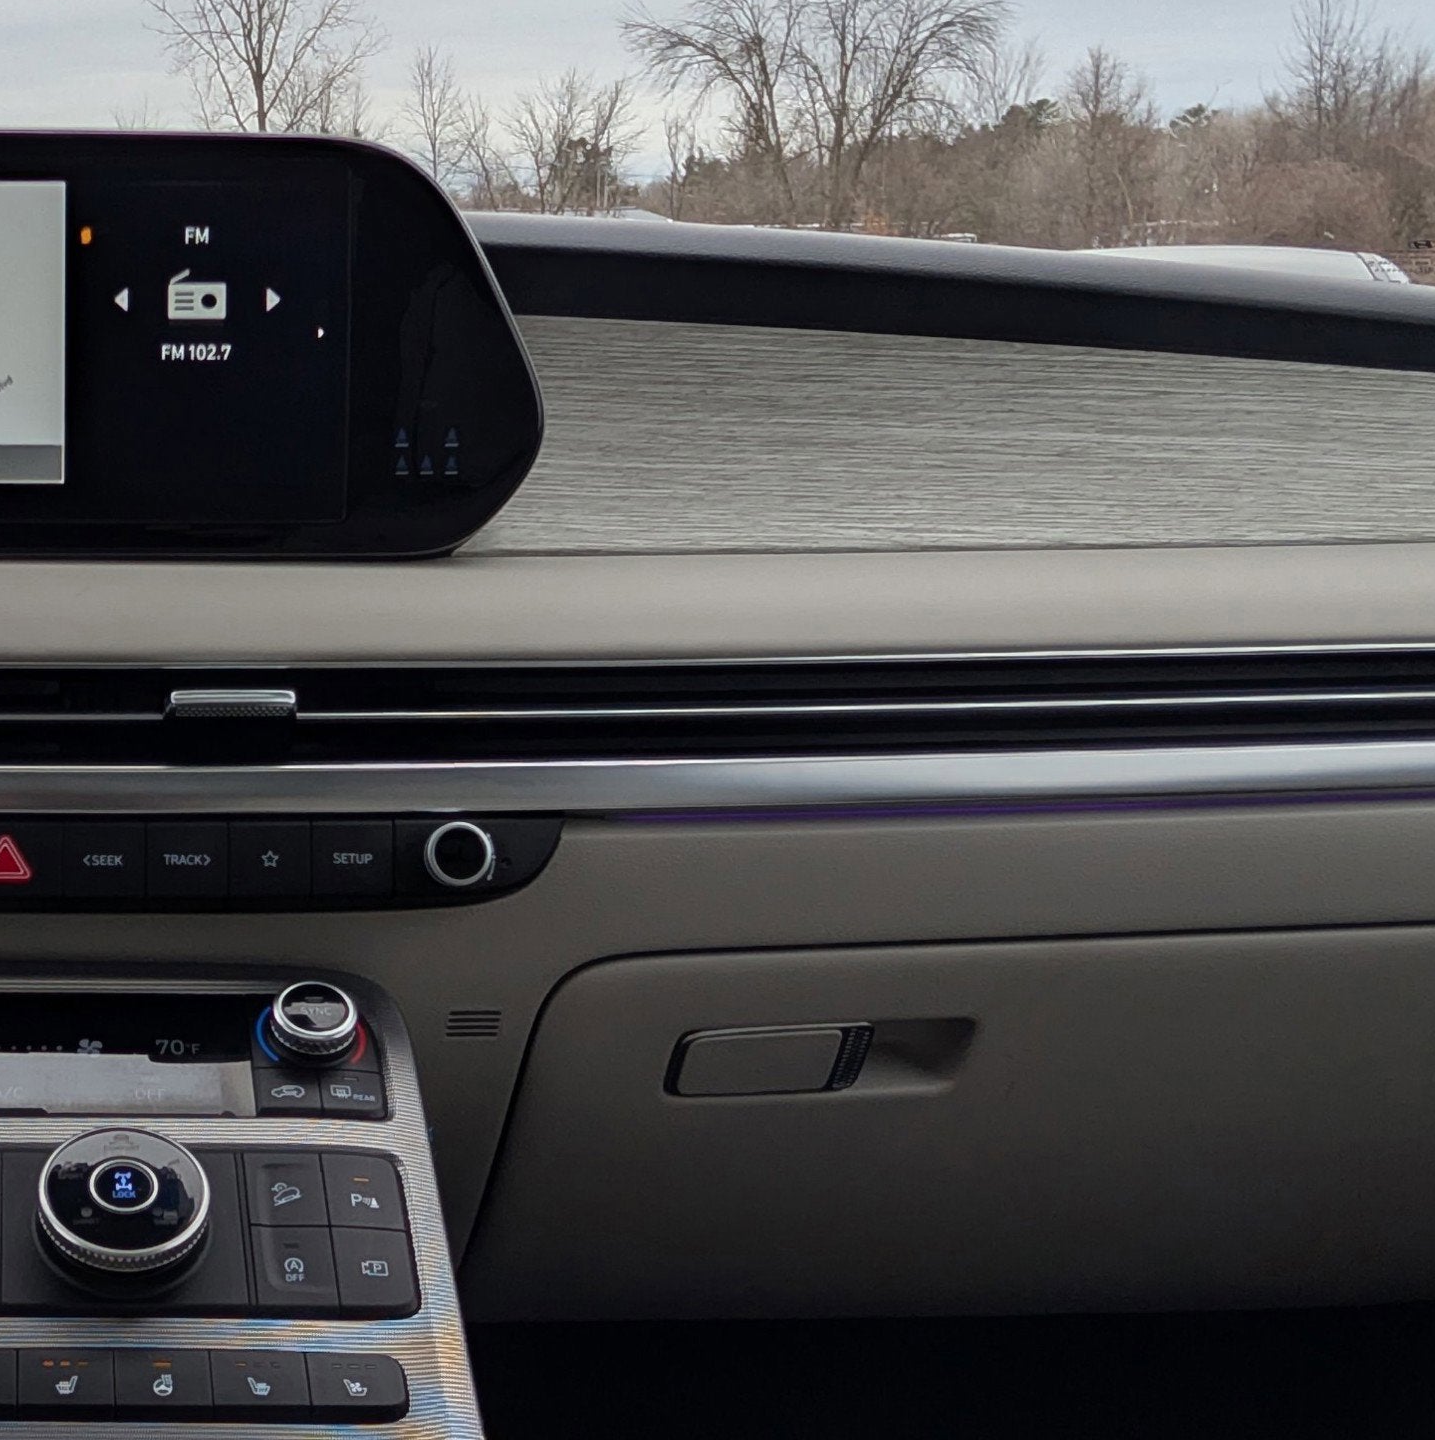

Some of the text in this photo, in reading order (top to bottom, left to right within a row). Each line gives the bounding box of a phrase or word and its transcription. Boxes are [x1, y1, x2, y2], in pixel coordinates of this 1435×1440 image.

[184, 226, 210, 245] FM
[161, 344, 232, 360] FM 102.7
[333, 852, 373, 865] SETUP
[299, 1005, 333, 1016] SYNC
[352, 1093, 375, 1103] REAR
[112, 1190, 136, 1198] LOCK
[285, 1274, 305, 1282] OFF
